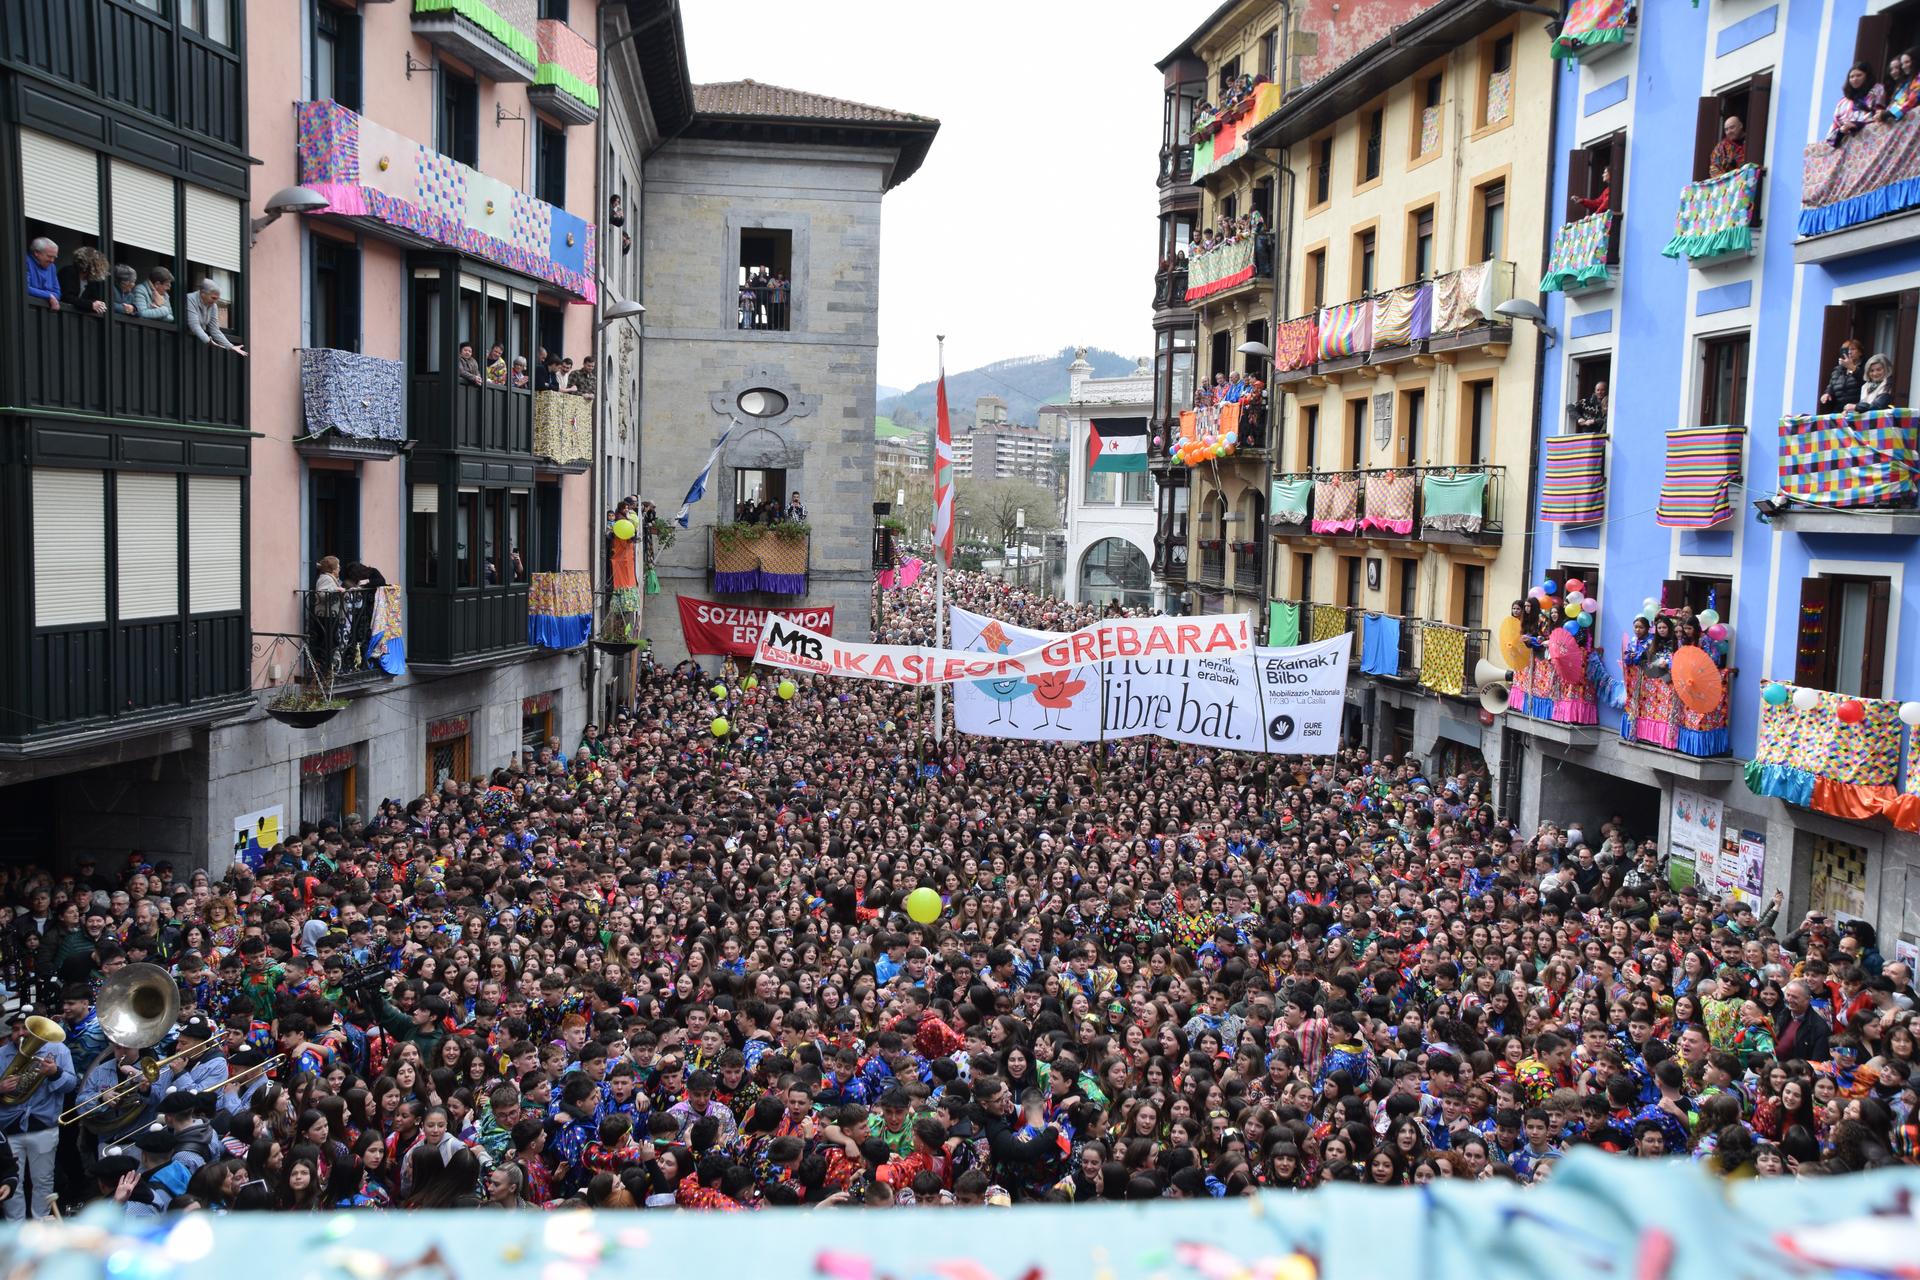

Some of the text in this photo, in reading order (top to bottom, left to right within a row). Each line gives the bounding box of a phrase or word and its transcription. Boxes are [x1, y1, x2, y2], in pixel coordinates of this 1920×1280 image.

[697, 605, 831, 628] SOZIALMOA
[768, 622, 823, 661] M13
[1041, 620, 1248, 667] GREBARA!
[1265, 651, 1339, 670] Ekainak 7
[1266, 671, 1308, 684] Bilbo
[1103, 679, 1242, 741] libre bat.
